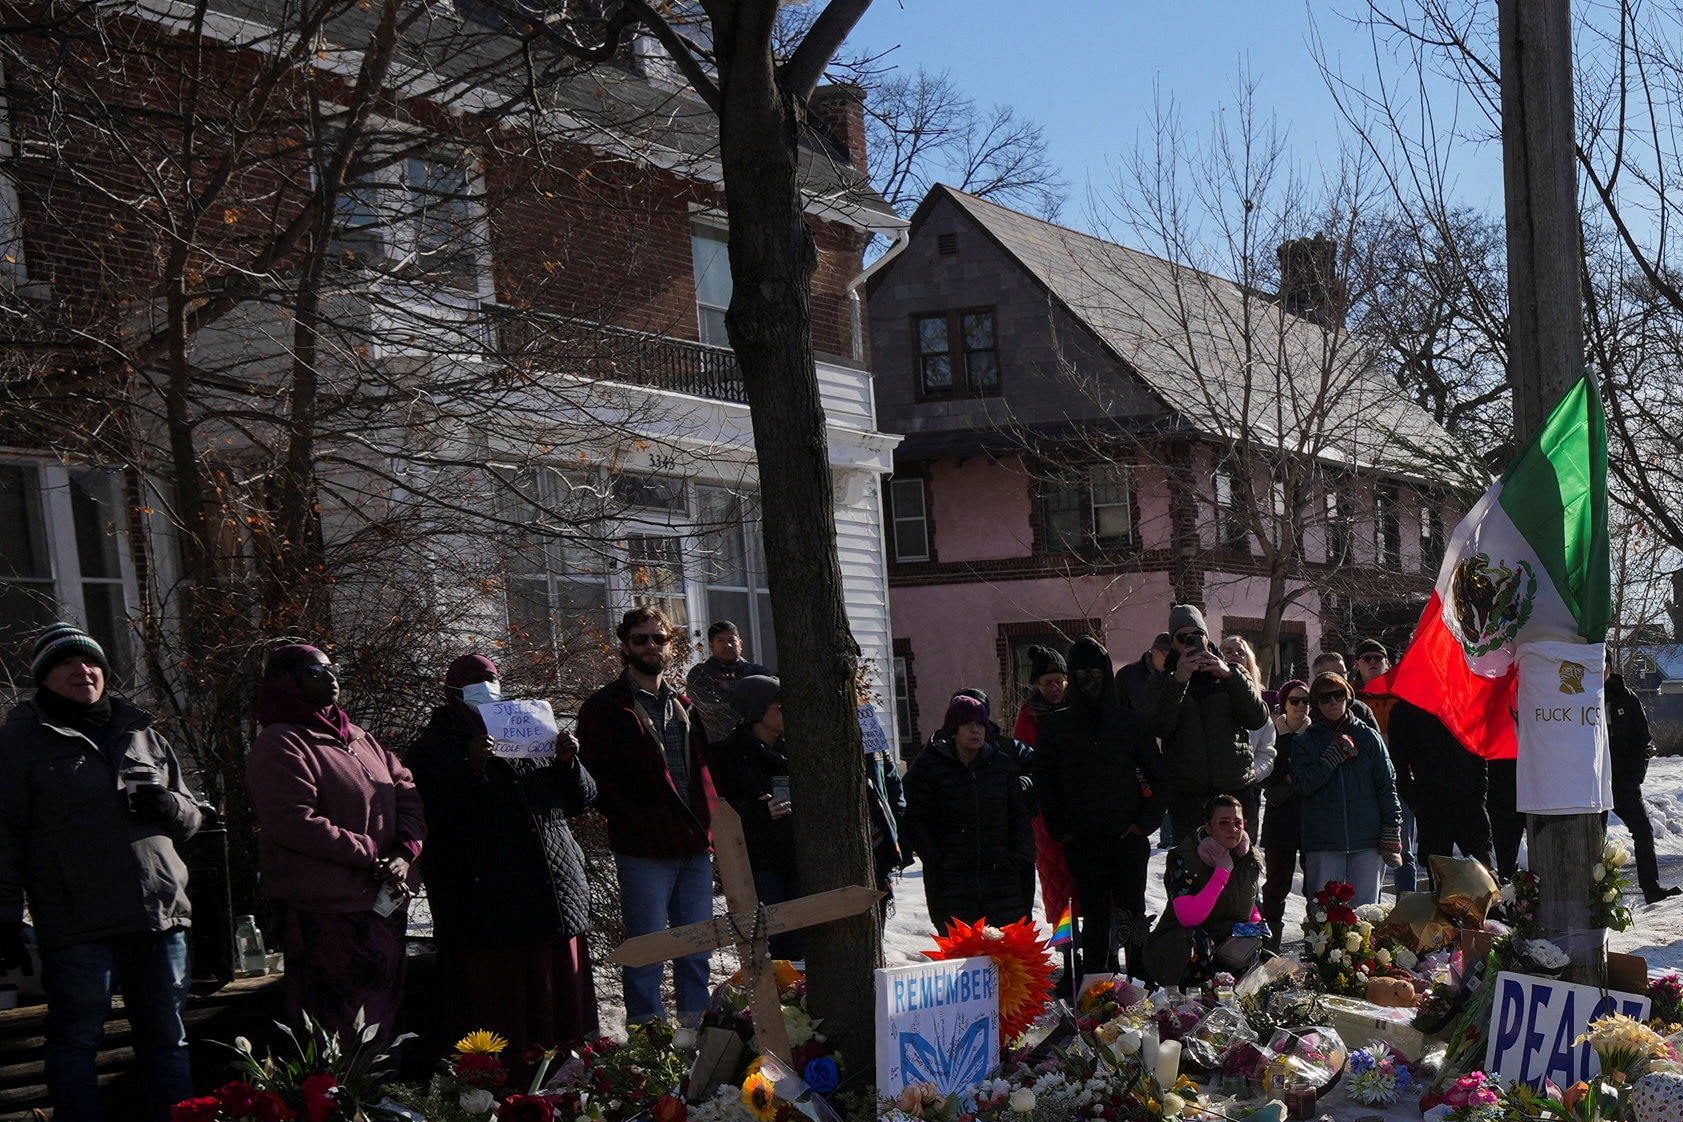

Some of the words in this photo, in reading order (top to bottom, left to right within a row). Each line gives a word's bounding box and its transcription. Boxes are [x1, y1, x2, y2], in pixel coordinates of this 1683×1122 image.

[511, 715, 531, 725] FOR
[1535, 707, 1572, 722] FUCK
[503, 726, 541, 739] RENEE
[493, 742, 524, 753] ICOLE
[895, 968, 992, 1014] REMEMBER
